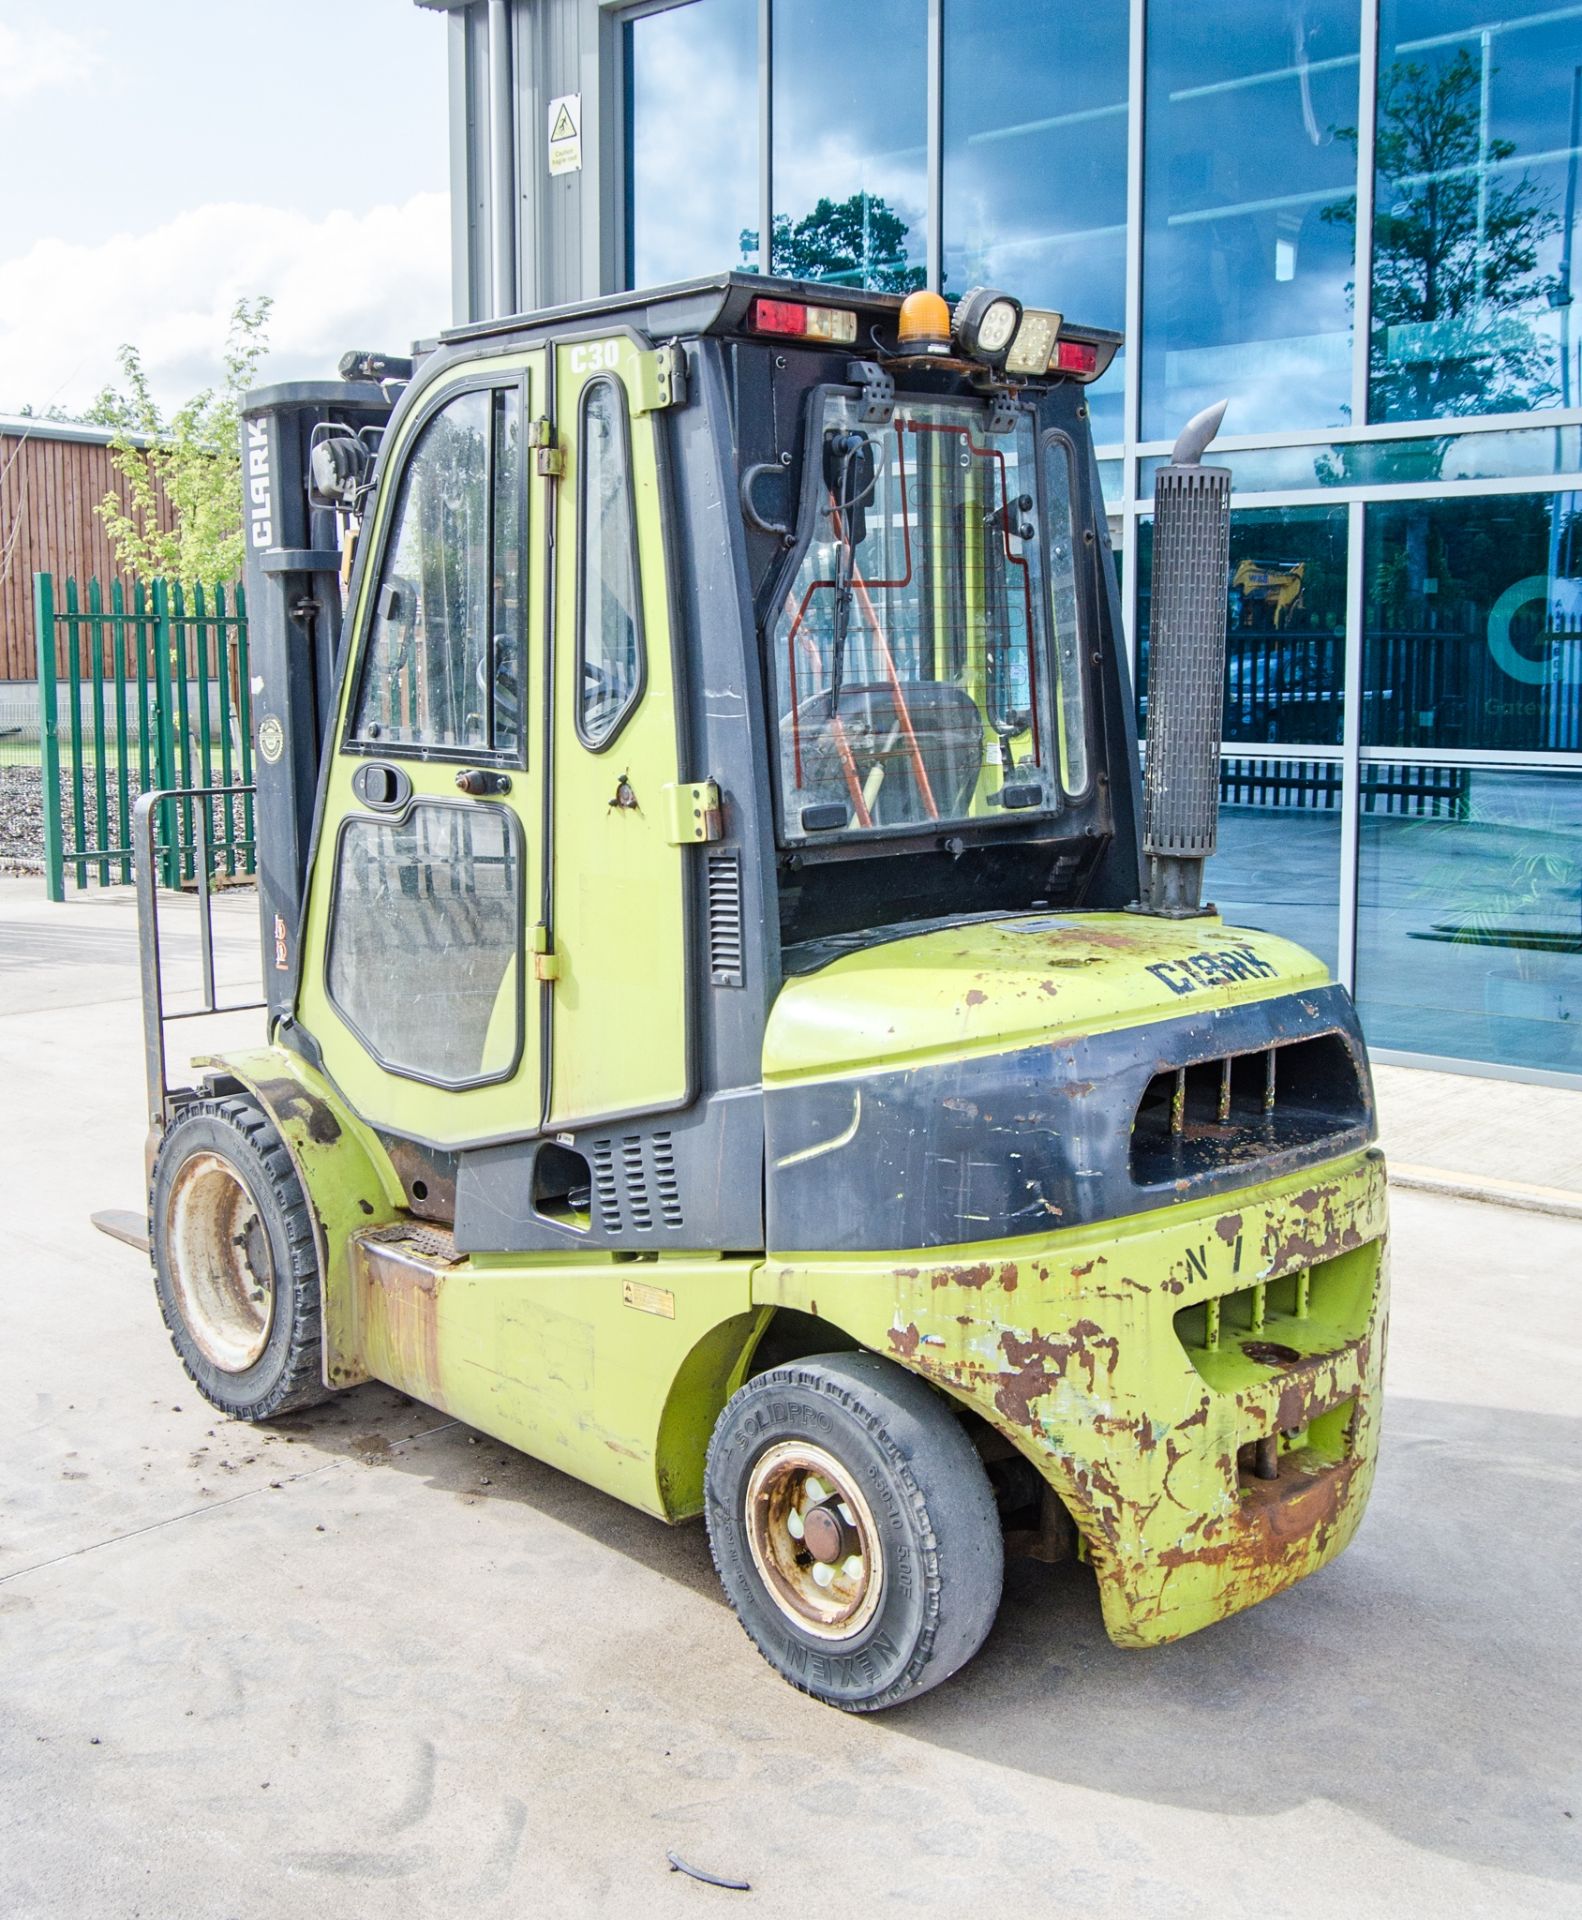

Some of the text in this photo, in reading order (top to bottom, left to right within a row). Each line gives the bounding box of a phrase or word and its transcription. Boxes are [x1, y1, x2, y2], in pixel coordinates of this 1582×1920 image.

[571, 339, 619, 374] C30
[247, 417, 273, 548] CLARK
[1145, 947, 1279, 996] CLARK
[734, 1401, 834, 1452] SOLIDPRO
[786, 1630, 901, 1688] NEXEN
